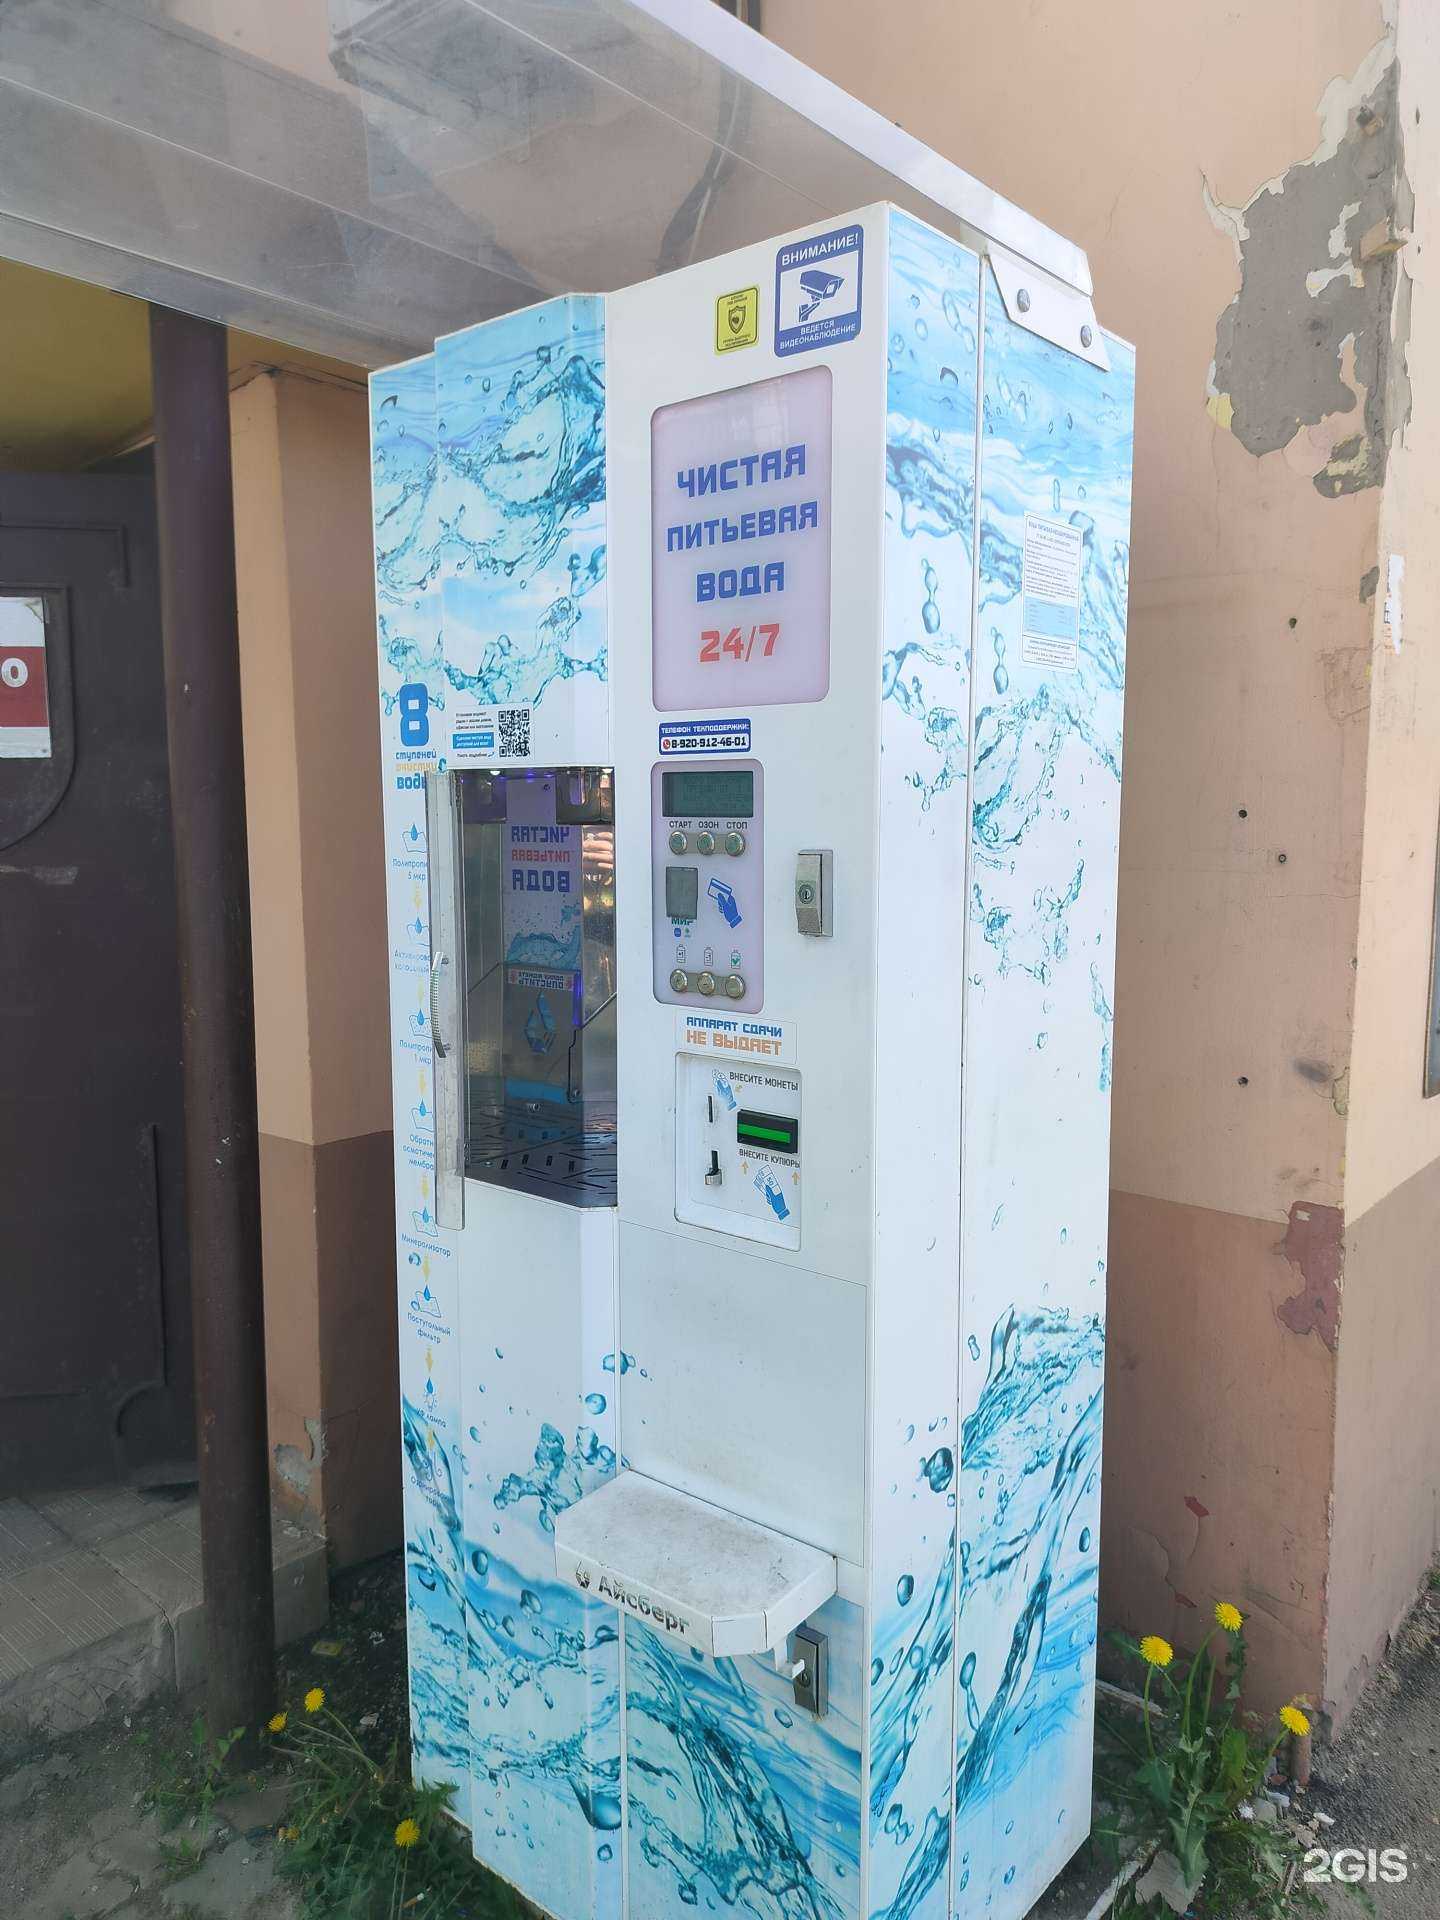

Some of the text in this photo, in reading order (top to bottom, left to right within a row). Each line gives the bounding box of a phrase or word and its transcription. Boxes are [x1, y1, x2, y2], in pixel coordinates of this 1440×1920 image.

[781, 233, 859, 266] ВНИМАНИЕ!
[780, 323, 856, 350] ВИДЕОНАБЛЮДЕНИЕ
[800, 320, 835, 335] ВЕДЕТСЯ
[677, 444, 806, 498] ЧИСТАЯ
[667, 500, 818, 552] ПИТЬЕВАЯ
[696, 561, 785, 602] ВОДА
[700, 623, 780, 662] 24/7
[400, 683, 429, 747] 8
[661, 726, 691, 734] ТЕЛЕФОН
[671, 736, 747, 749] 8-920-912-46-01
[396, 748, 437, 761] ступеней
[669, 820, 748, 830] СТАРТ ОЗОН СТОП
[686, 1016, 782, 1038] АППАРАТ СДАЧИ
[686, 1030, 782, 1056] НЕ ВЫДАЕТ
[729, 1071, 799, 1091] ВНЕСИТЕ МОНЕТЫ
[739, 1148, 801, 1169] ВНЕСИТЕ КУПЮРЫ
[401, 1233, 451, 1257] Минерализатор
[598, 1575, 690, 1634] Айсберг
